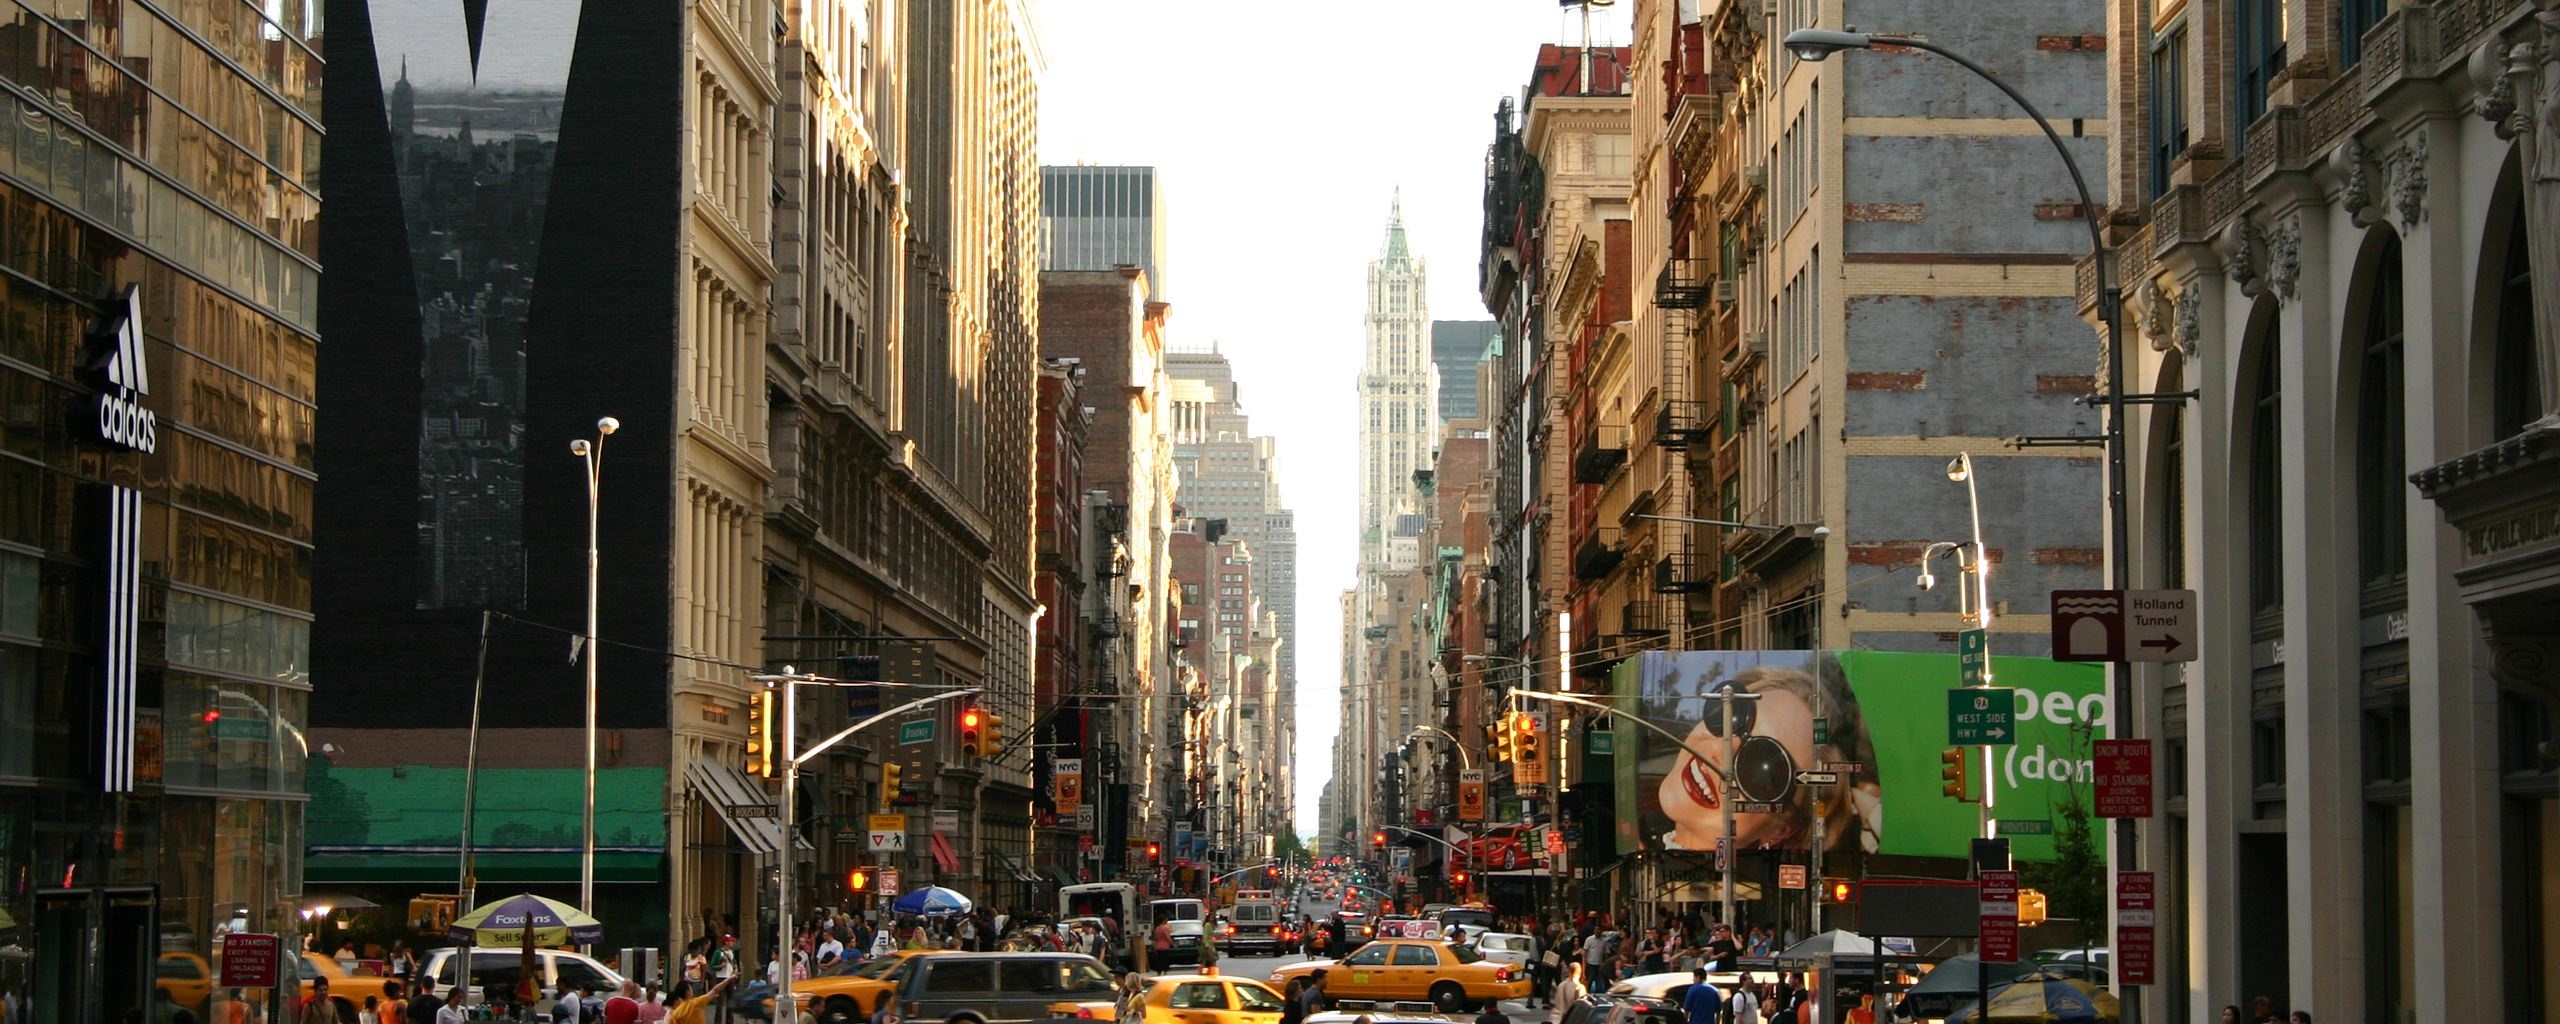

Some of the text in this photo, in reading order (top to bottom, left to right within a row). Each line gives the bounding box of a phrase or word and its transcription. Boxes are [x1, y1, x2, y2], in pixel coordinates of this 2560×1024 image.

[101, 386, 155, 454] adidas
[2134, 599, 2183, 609] Holland
[2135, 615, 2176, 625] Tunnel
[1976, 699, 1987, 708] 9A
[1957, 713, 2006, 723] WEST SIDE
[1957, 729, 1977, 738] HWY
[2096, 744, 2149, 756] SNOW ROUTE
[1059, 763, 1078, 771] NYC
[2096, 775, 2149, 786] NO STANDING
[729, 807, 777, 817] E HOUSTON ST
[1744, 803, 1770, 813] HOUSTON
[1776, 803, 1783, 813] ST
[1079, 815, 1092, 823] 30
[496, 914, 551, 925] Foxtns
[494, 932, 515, 943] Sell
[240, 939, 273, 947] STANDING
